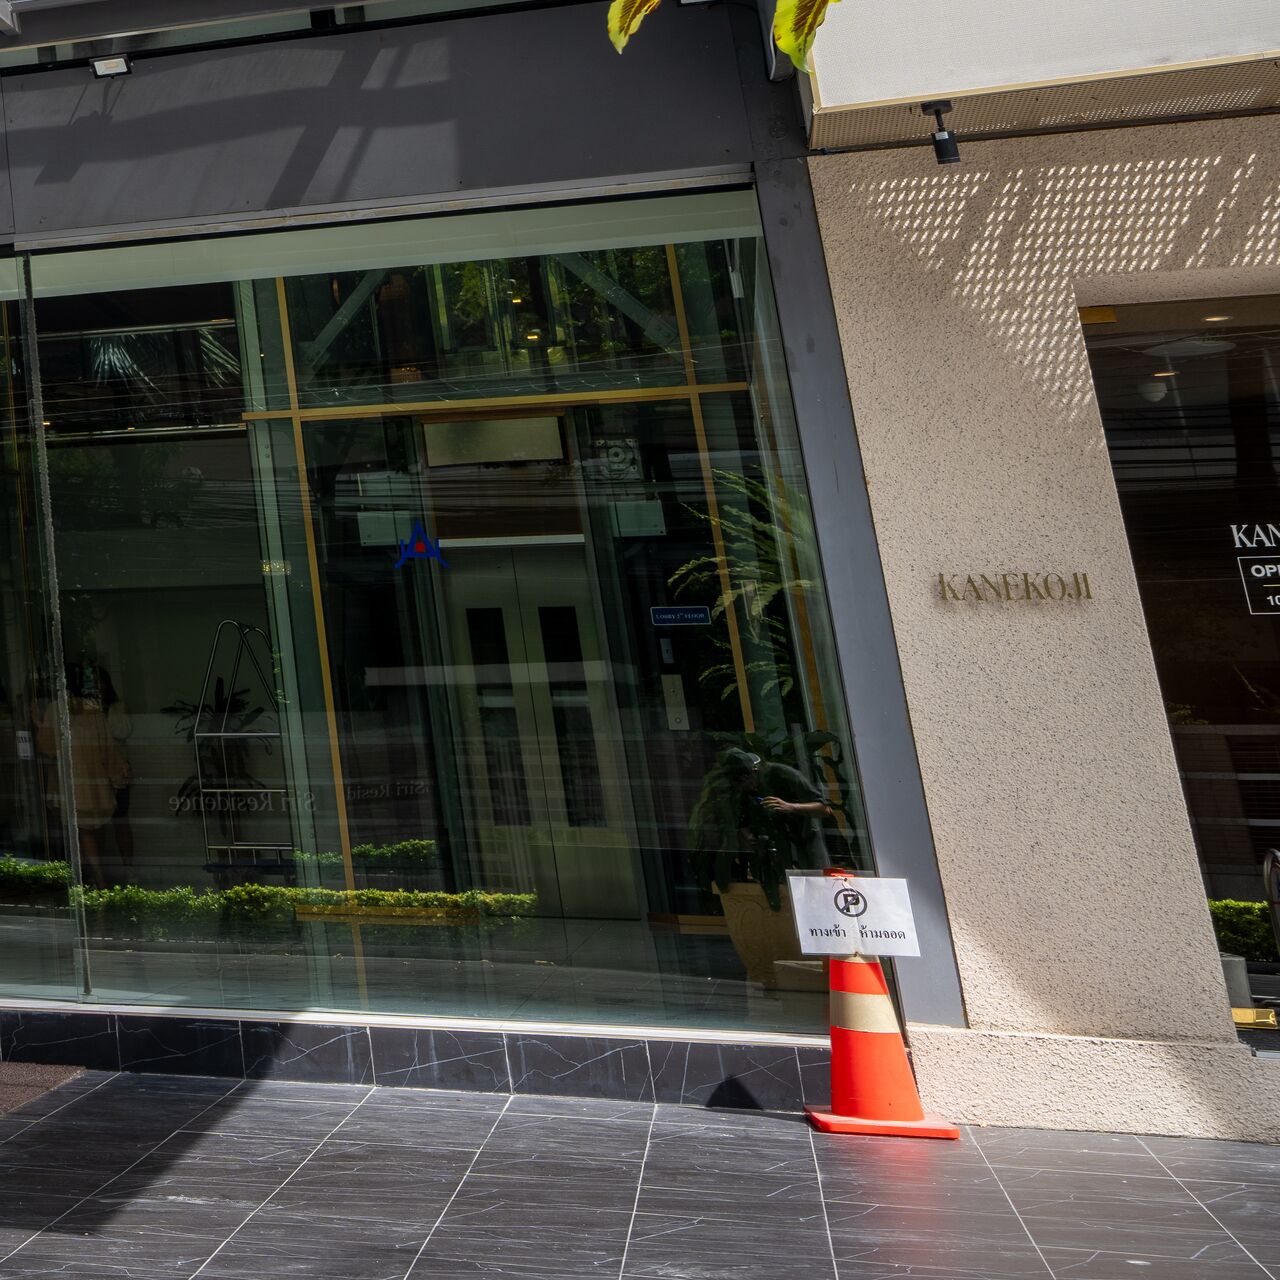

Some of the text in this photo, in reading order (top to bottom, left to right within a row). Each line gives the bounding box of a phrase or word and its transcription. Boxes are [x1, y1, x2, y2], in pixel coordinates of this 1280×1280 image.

[1251, 564, 1280, 578] OP
[936, 572, 1093, 601] KANEKOJI
[808, 924, 906, 940] ทางเข้า ห้ามจอด
